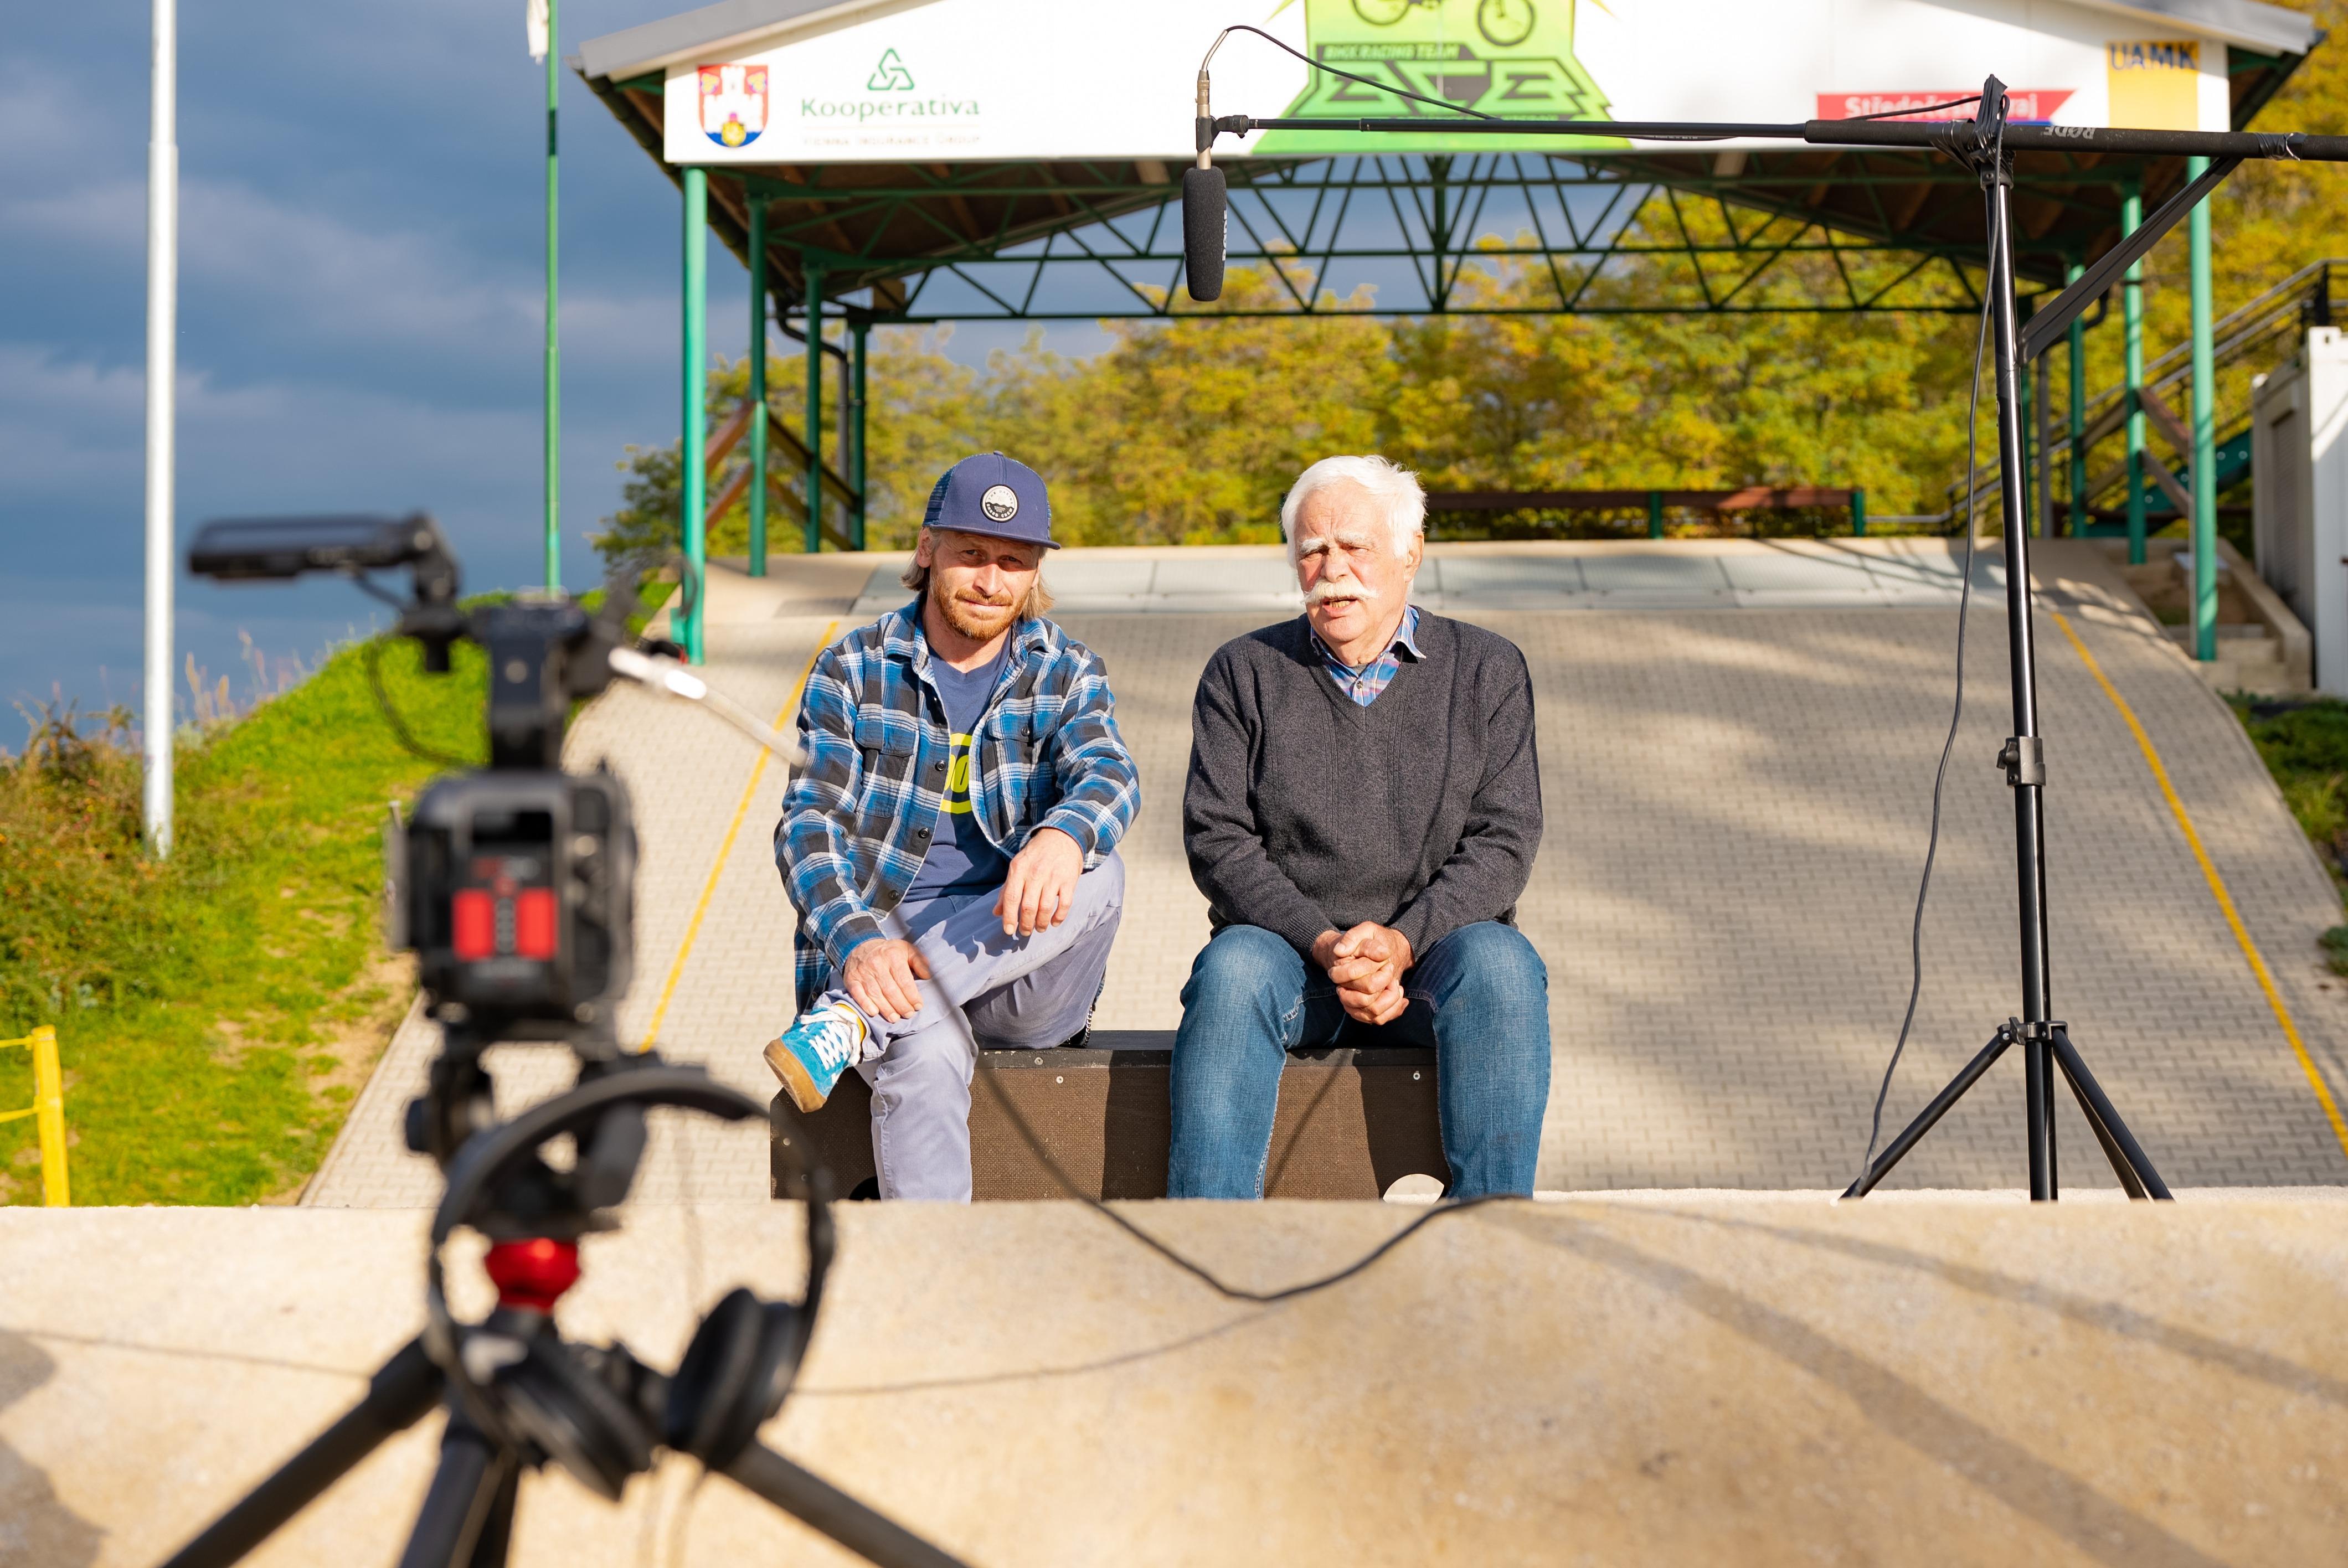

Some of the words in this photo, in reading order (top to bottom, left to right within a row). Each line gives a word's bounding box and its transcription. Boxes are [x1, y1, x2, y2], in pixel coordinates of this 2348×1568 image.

[1358, 44, 1415, 60] RACING
[1416, 43, 1460, 59] TEAM
[801, 95, 979, 122] Kooperativa
[2003, 92, 2038, 121] raj
